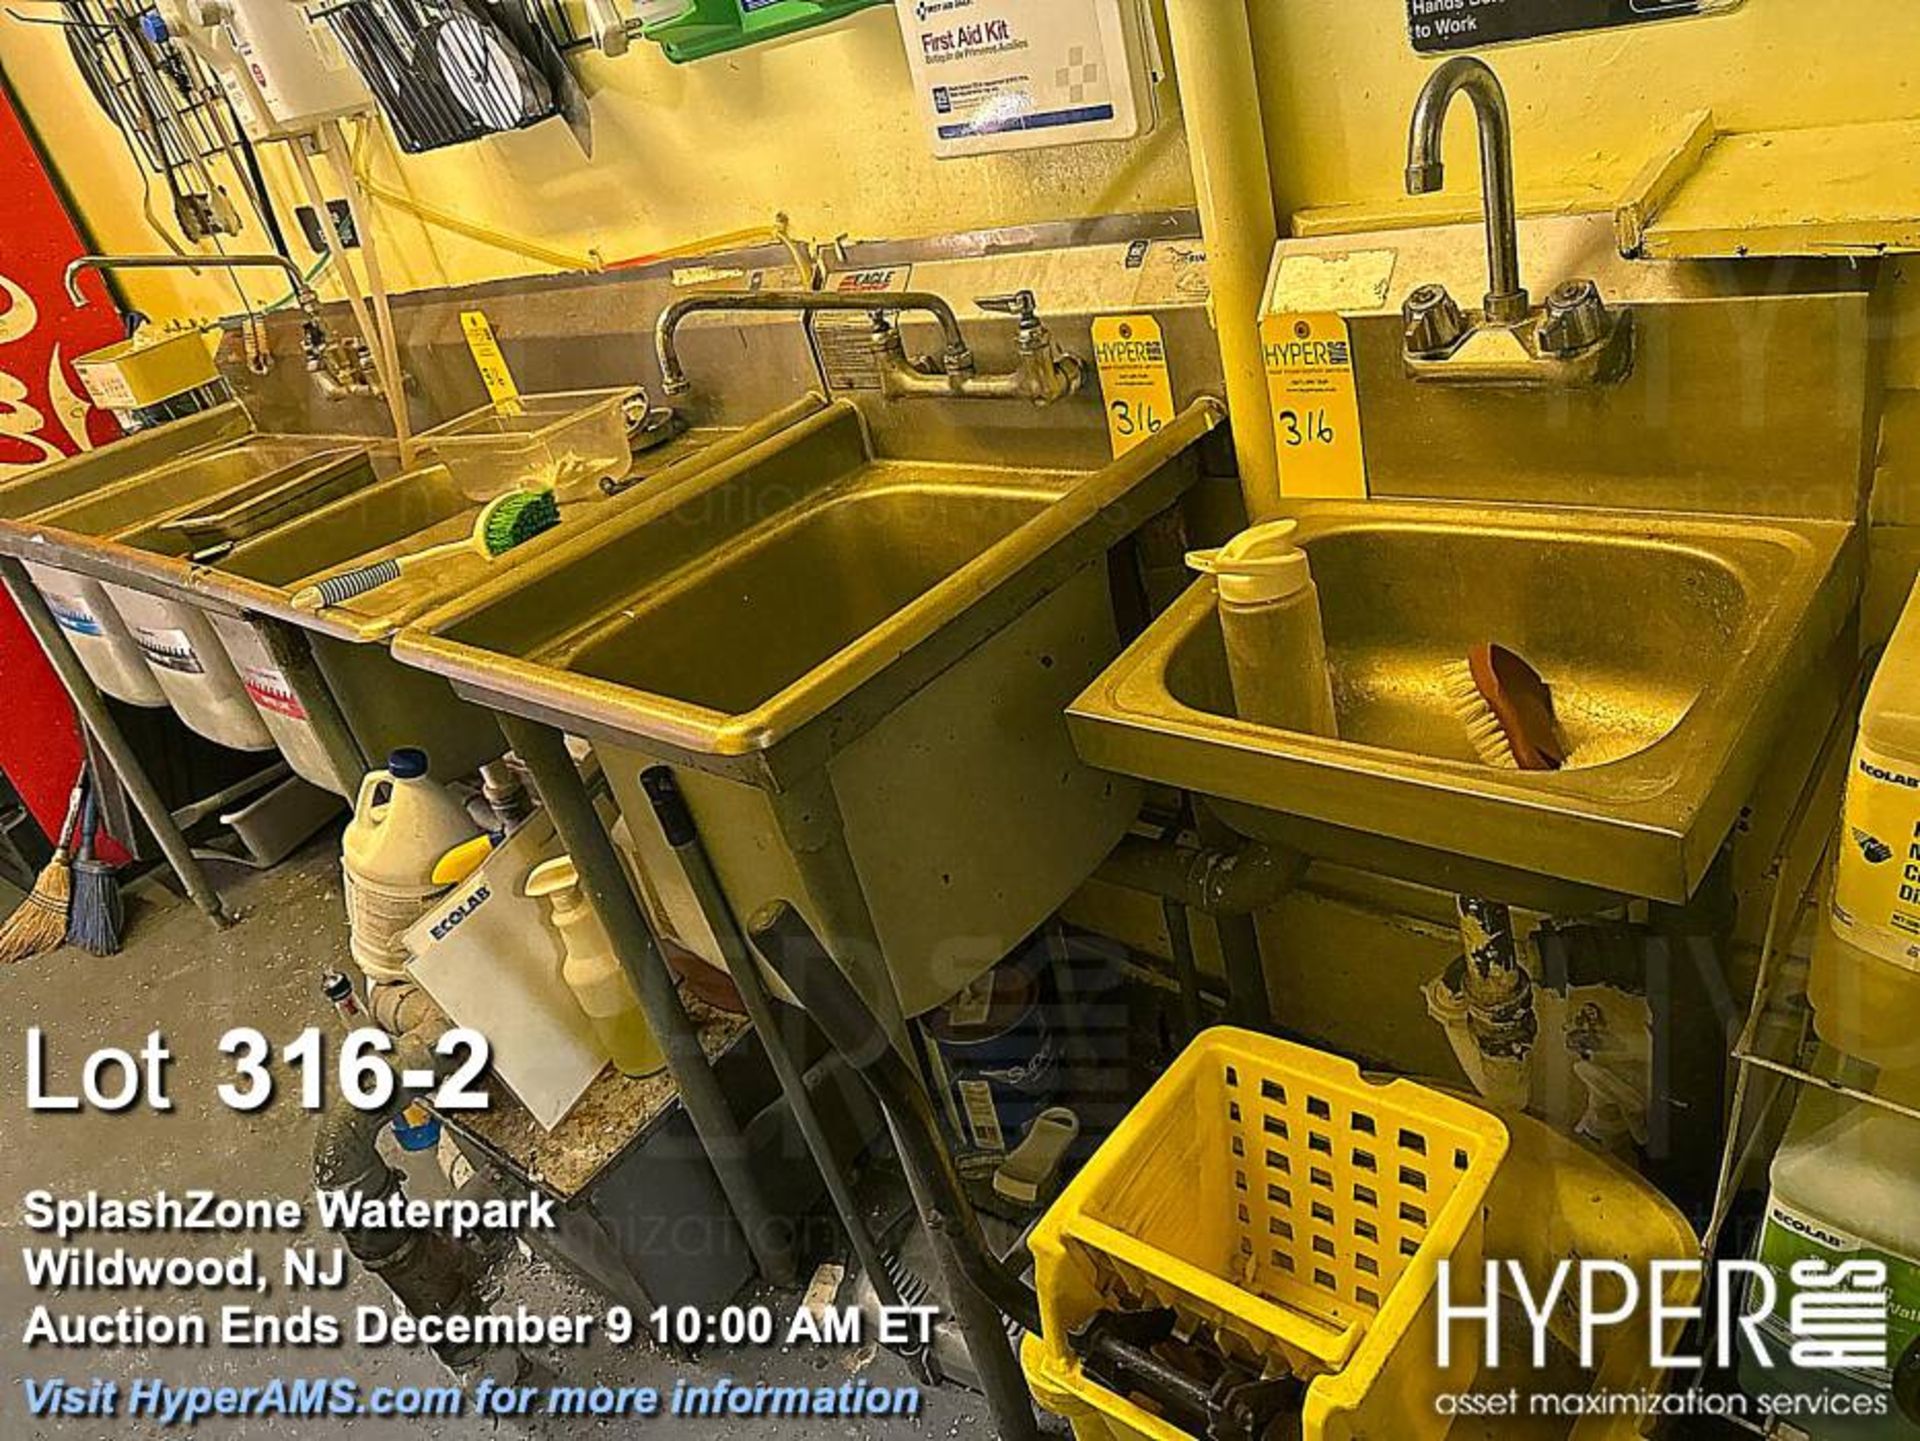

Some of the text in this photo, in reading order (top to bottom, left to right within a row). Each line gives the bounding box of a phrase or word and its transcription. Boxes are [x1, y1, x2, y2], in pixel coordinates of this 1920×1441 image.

[1412, 0, 1464, 16] Hands
[921, 19, 1009, 53] First Aid Kit
[1414, 15, 1478, 39] to Work
[1097, 341, 1146, 363] HYPER
[1265, 341, 1327, 366] HYPER
[1111, 400, 1162, 436] 316
[1279, 409, 1335, 446] 316
[1860, 758, 1919, 788] ECOLAB
[430, 886, 490, 940] ECOLAB
[1774, 1208, 1845, 1247] ECOLAB
